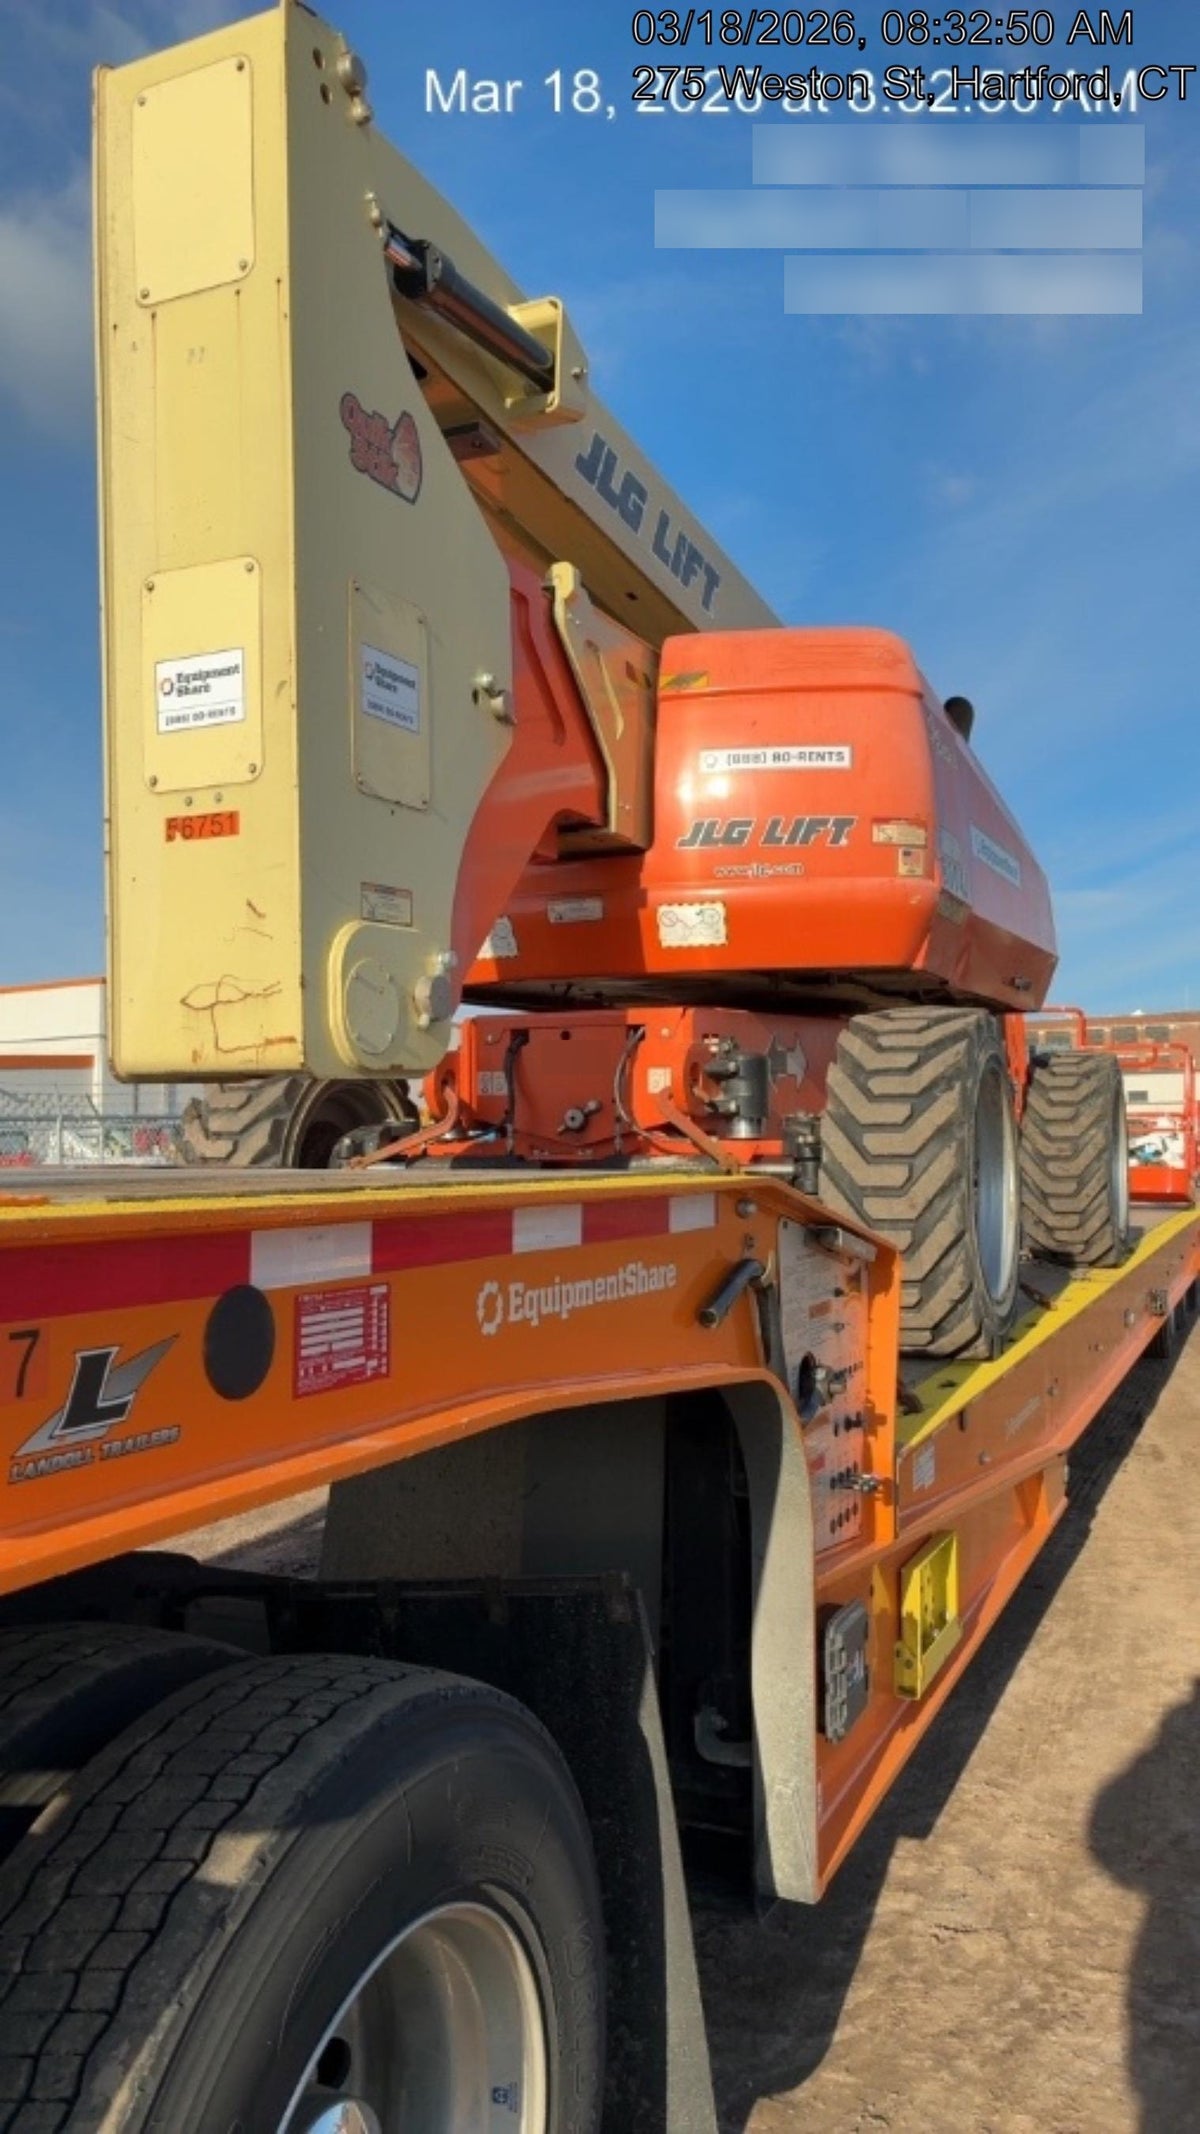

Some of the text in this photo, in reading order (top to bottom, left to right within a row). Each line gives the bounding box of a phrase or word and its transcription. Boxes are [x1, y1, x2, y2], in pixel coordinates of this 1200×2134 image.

[574, 431, 722, 612] JLG LIFT
[677, 818, 753, 849] JLG
[758, 815, 858, 847] LIFT
[507, 1261, 678, 1327] EquipmentShare
[8, 1328, 41, 1398] 7
